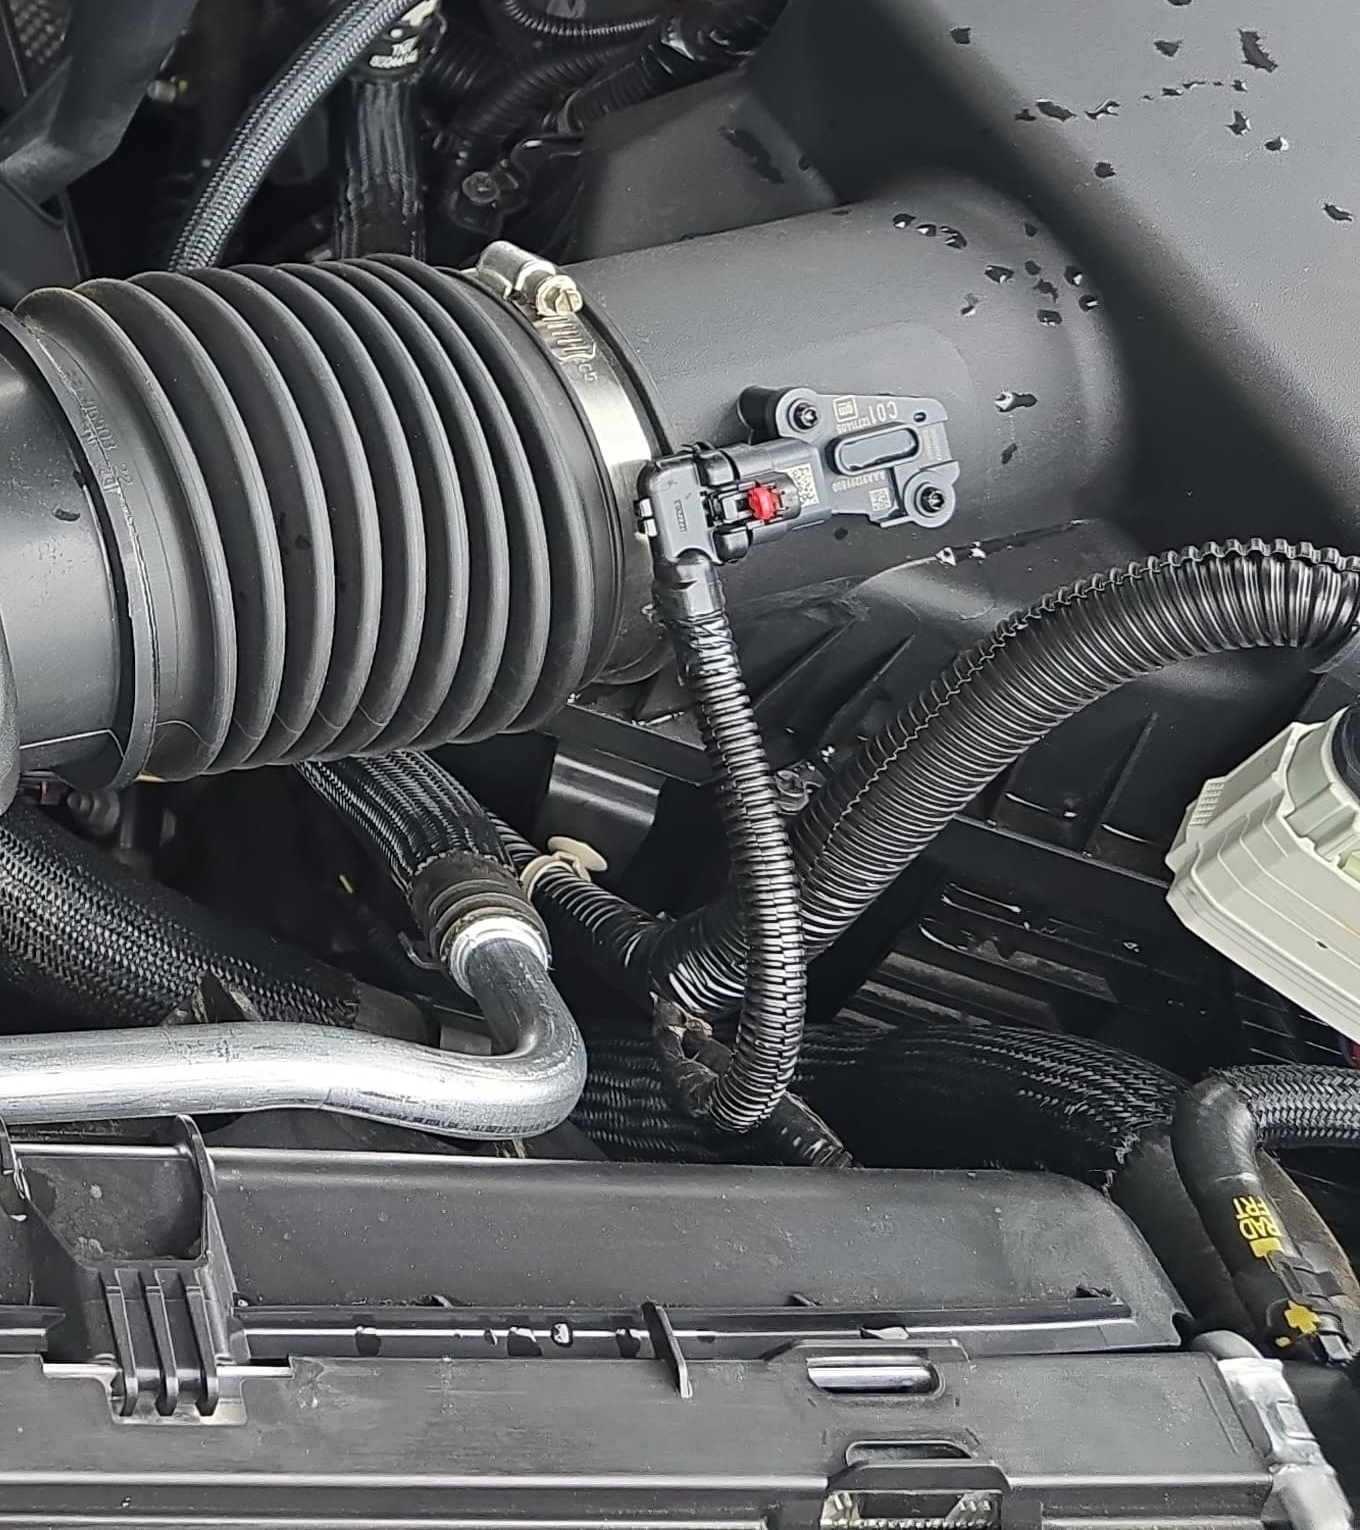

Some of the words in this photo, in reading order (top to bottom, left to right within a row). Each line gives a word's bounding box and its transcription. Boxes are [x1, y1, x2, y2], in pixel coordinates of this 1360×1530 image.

[868, 401, 898, 425] C01
[1231, 1195, 1270, 1219] FRT
[1239, 1216, 1281, 1239] RAD
